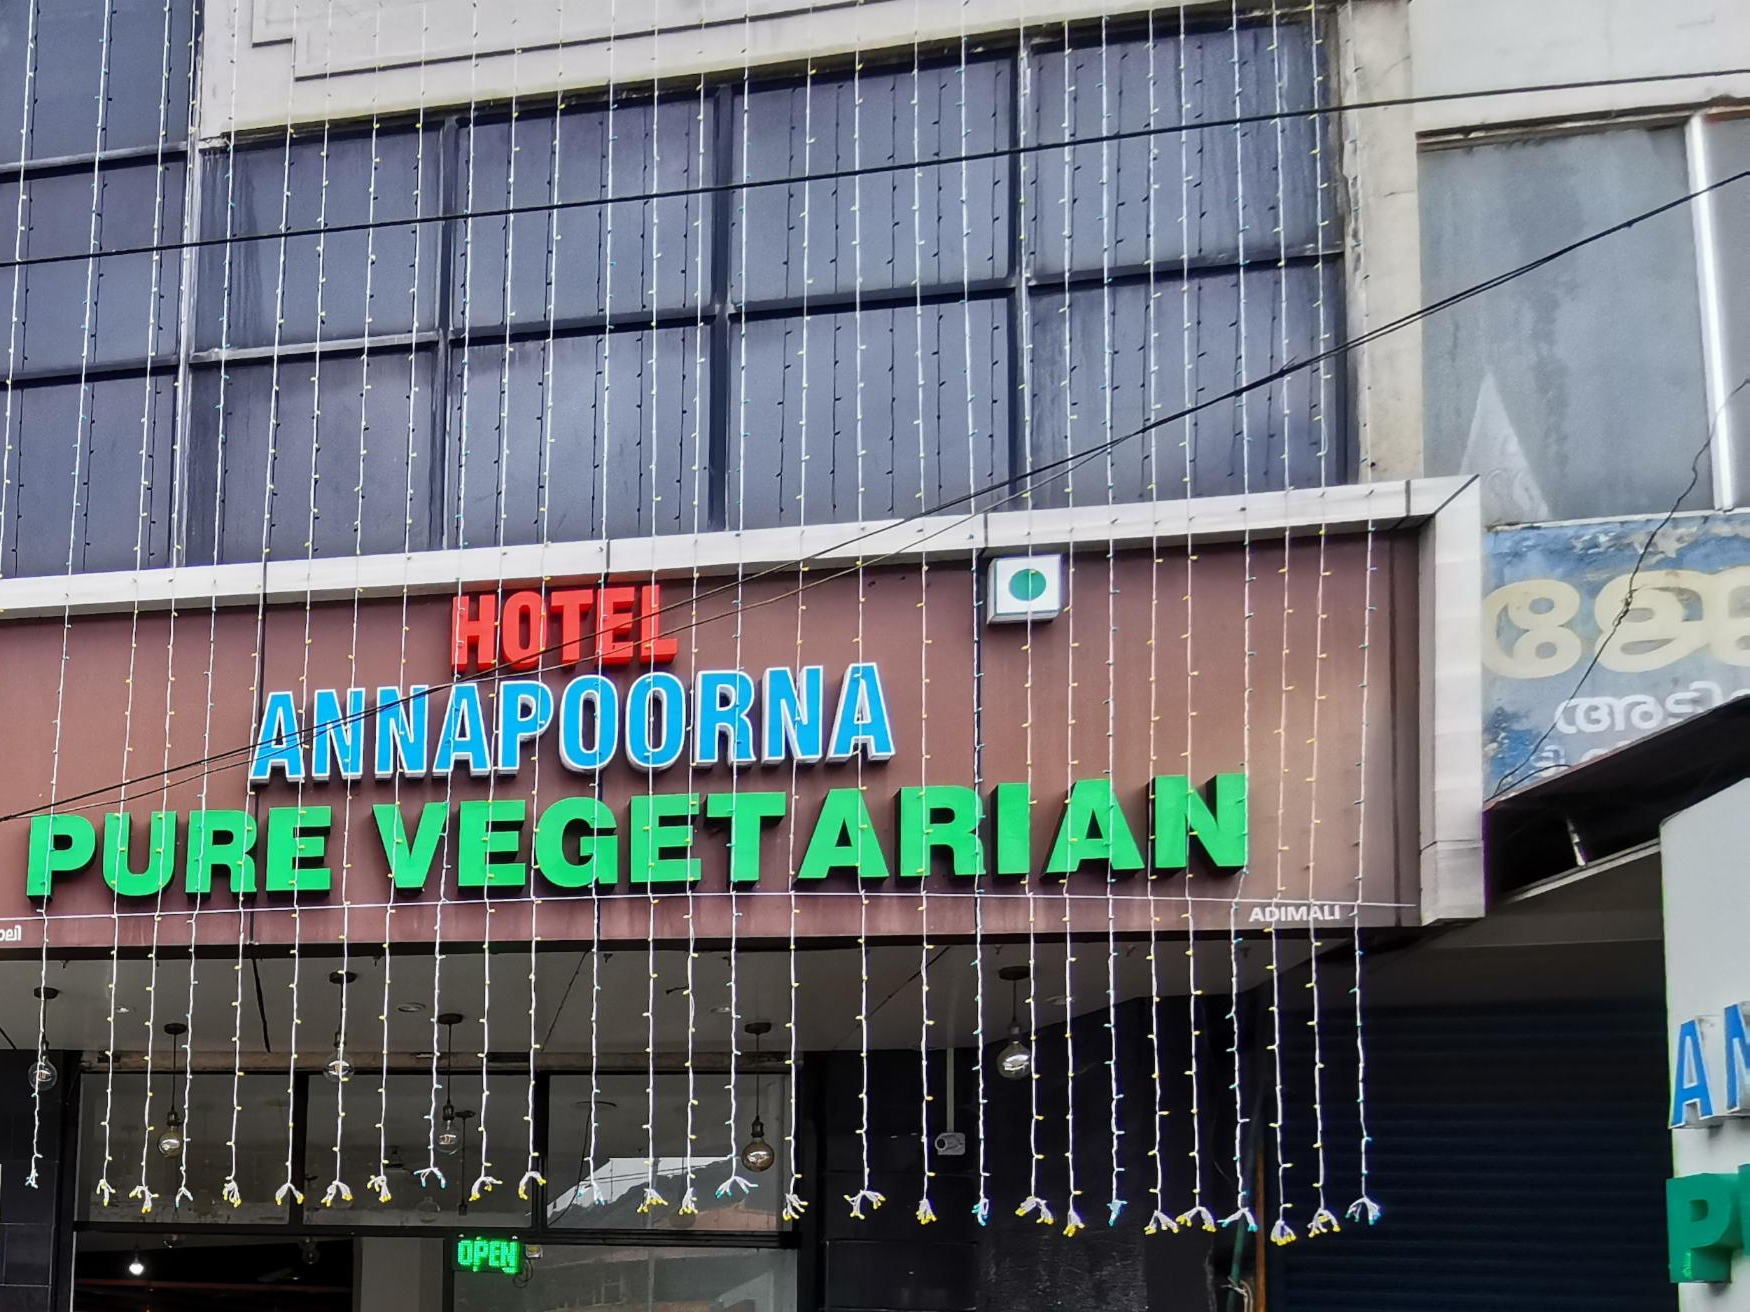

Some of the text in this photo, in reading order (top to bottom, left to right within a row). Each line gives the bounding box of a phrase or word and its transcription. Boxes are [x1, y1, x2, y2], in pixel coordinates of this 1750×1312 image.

[453, 584, 678, 673] HOTEL
[250, 661, 896, 784] ANNAPOORNA
[27, 773, 1247, 899] PURE VEGETARIAN
[1249, 904, 1340, 922] ADIMALI
[458, 1239, 519, 1267] OPEN
[1666, 1164, 1750, 1283] P
